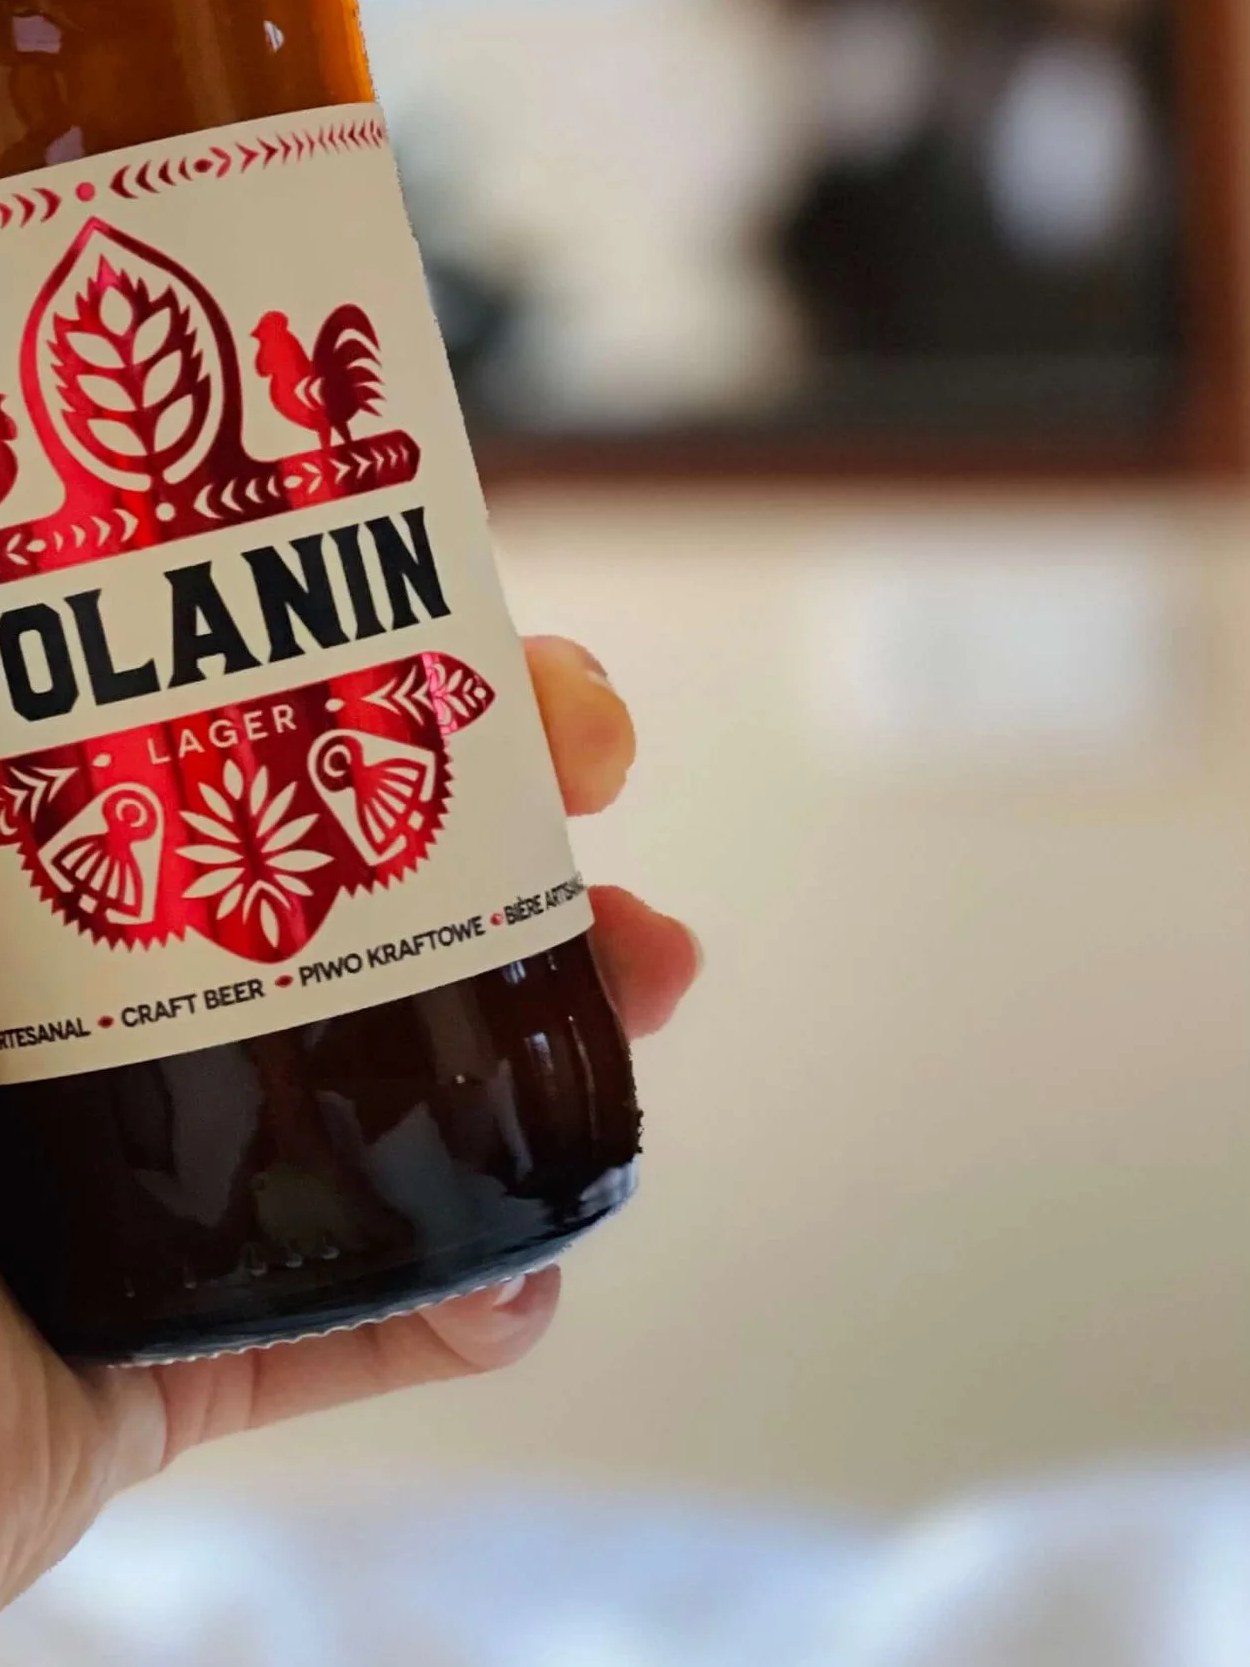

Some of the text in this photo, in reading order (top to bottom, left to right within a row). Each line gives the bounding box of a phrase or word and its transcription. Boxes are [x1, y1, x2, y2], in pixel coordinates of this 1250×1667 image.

[148, 704, 298, 765] LAGER
[299, 915, 486, 987] PIWO KRAFTOWE
[121, 978, 265, 1027] CRAFT BEER
